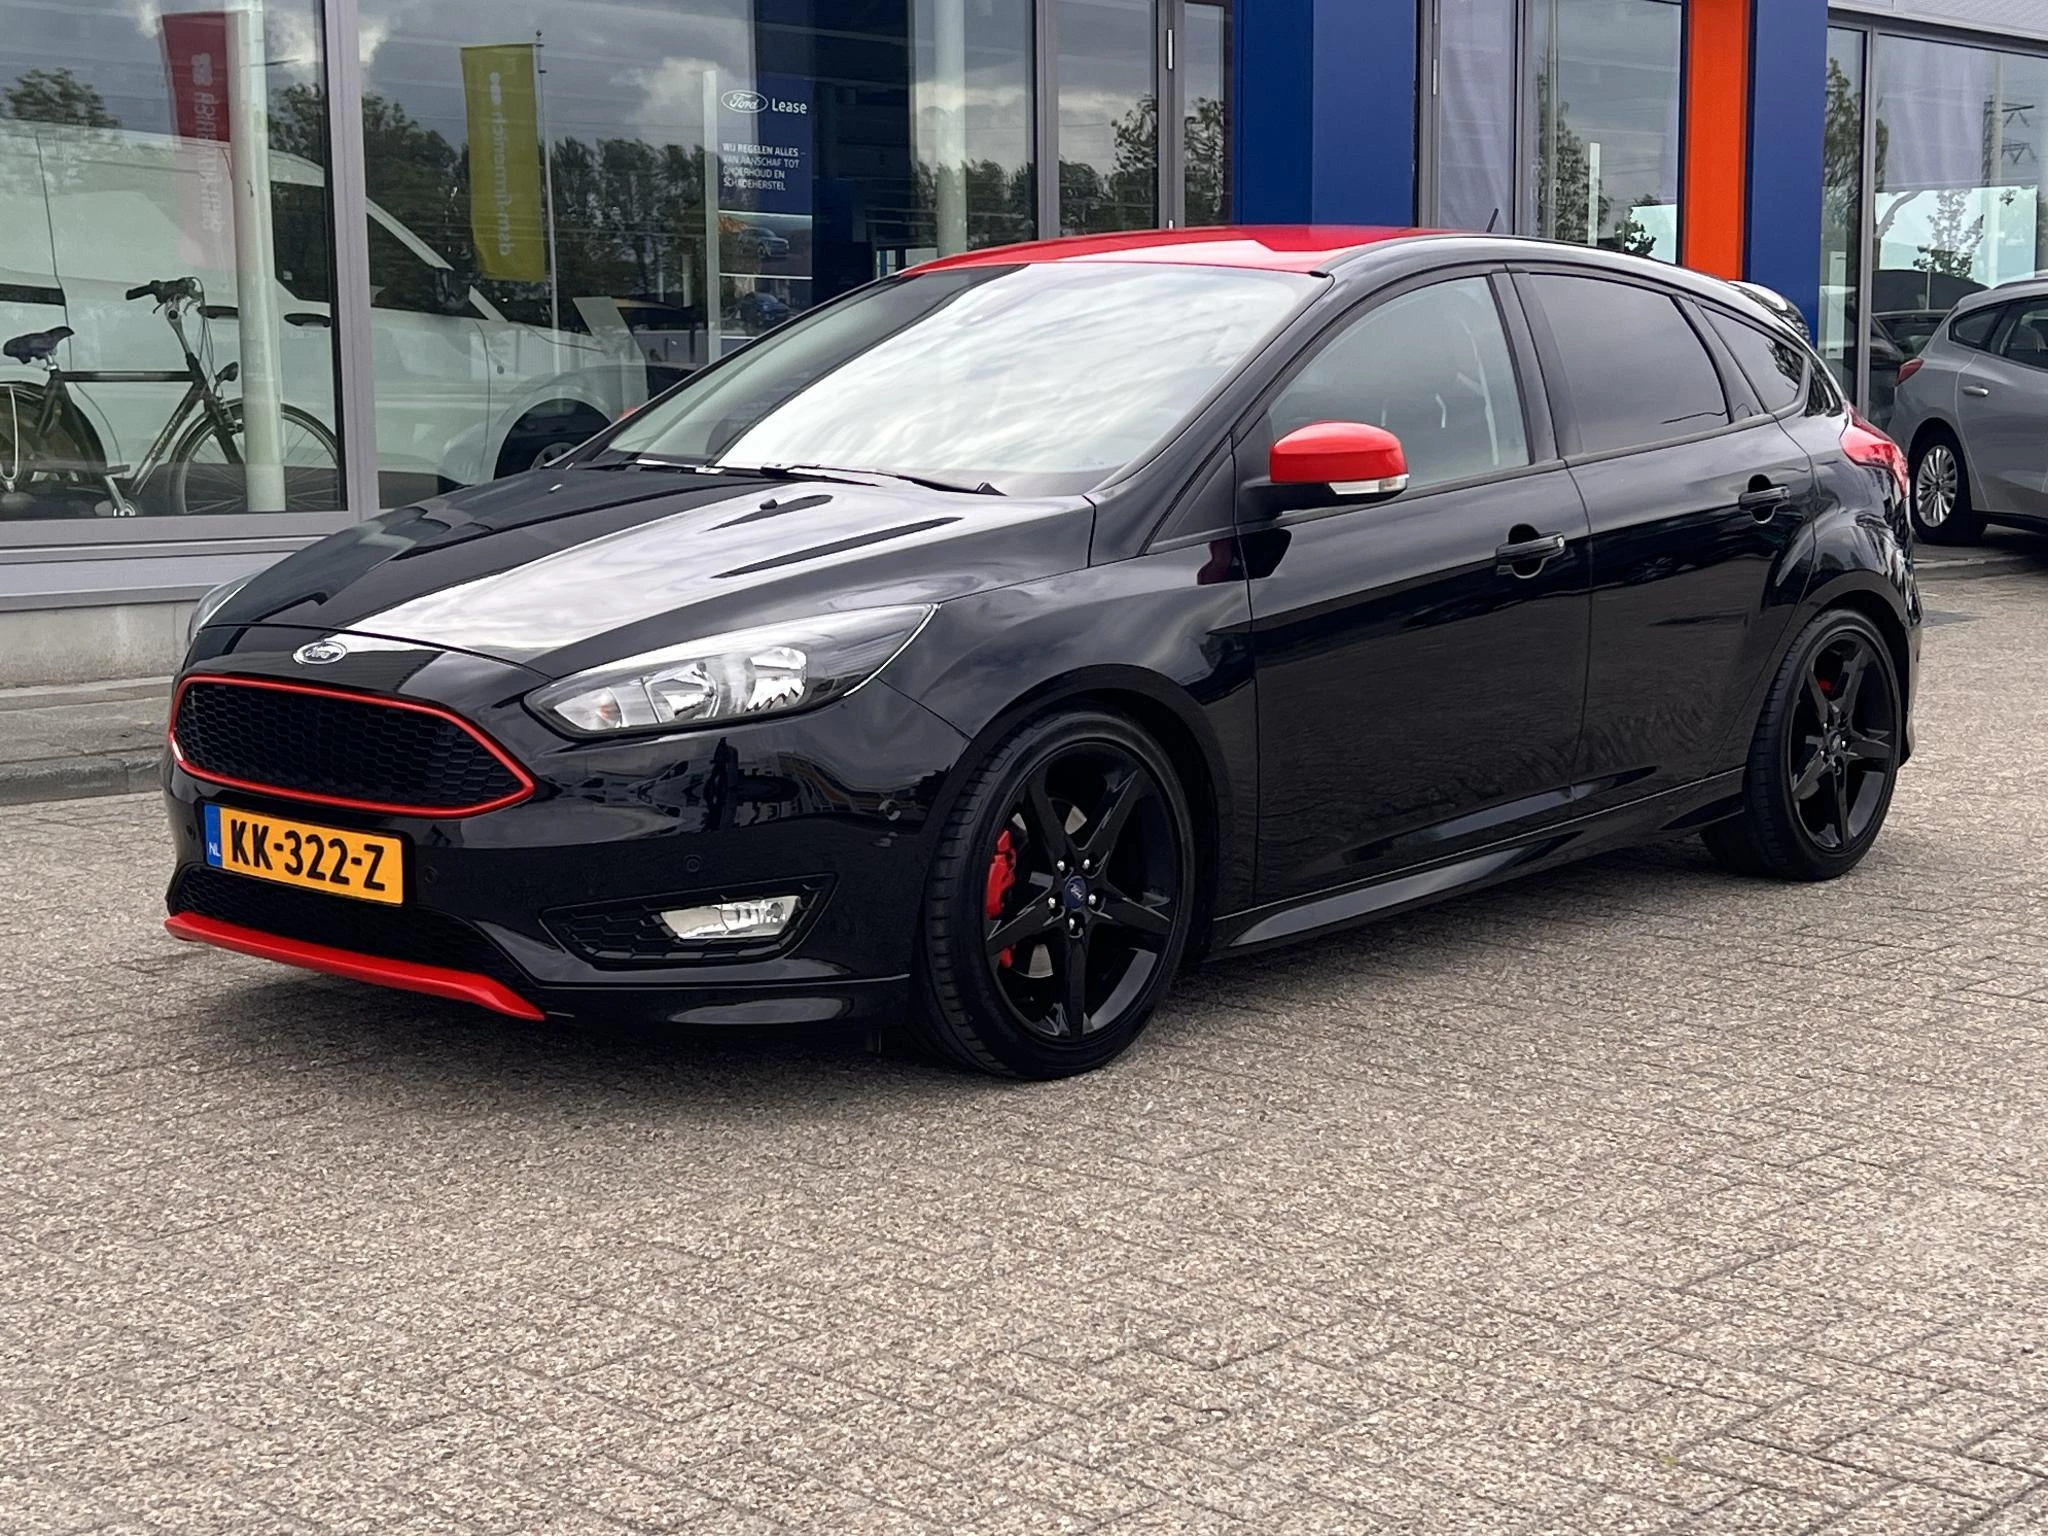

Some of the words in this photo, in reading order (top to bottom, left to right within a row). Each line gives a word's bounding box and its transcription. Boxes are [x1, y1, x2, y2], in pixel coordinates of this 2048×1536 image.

[729, 93, 759, 109] Ford
[771, 98, 807, 114] Lease
[738, 143, 773, 155] REGELEN
[774, 146, 799, 157] ALLES
[784, 158, 800, 169] TOT
[723, 165, 772, 178] ONDERHOUD
[773, 169, 785, 179] EN
[208, 843, 221, 857] NL
[230, 818, 386, 892] KK-322-Z
